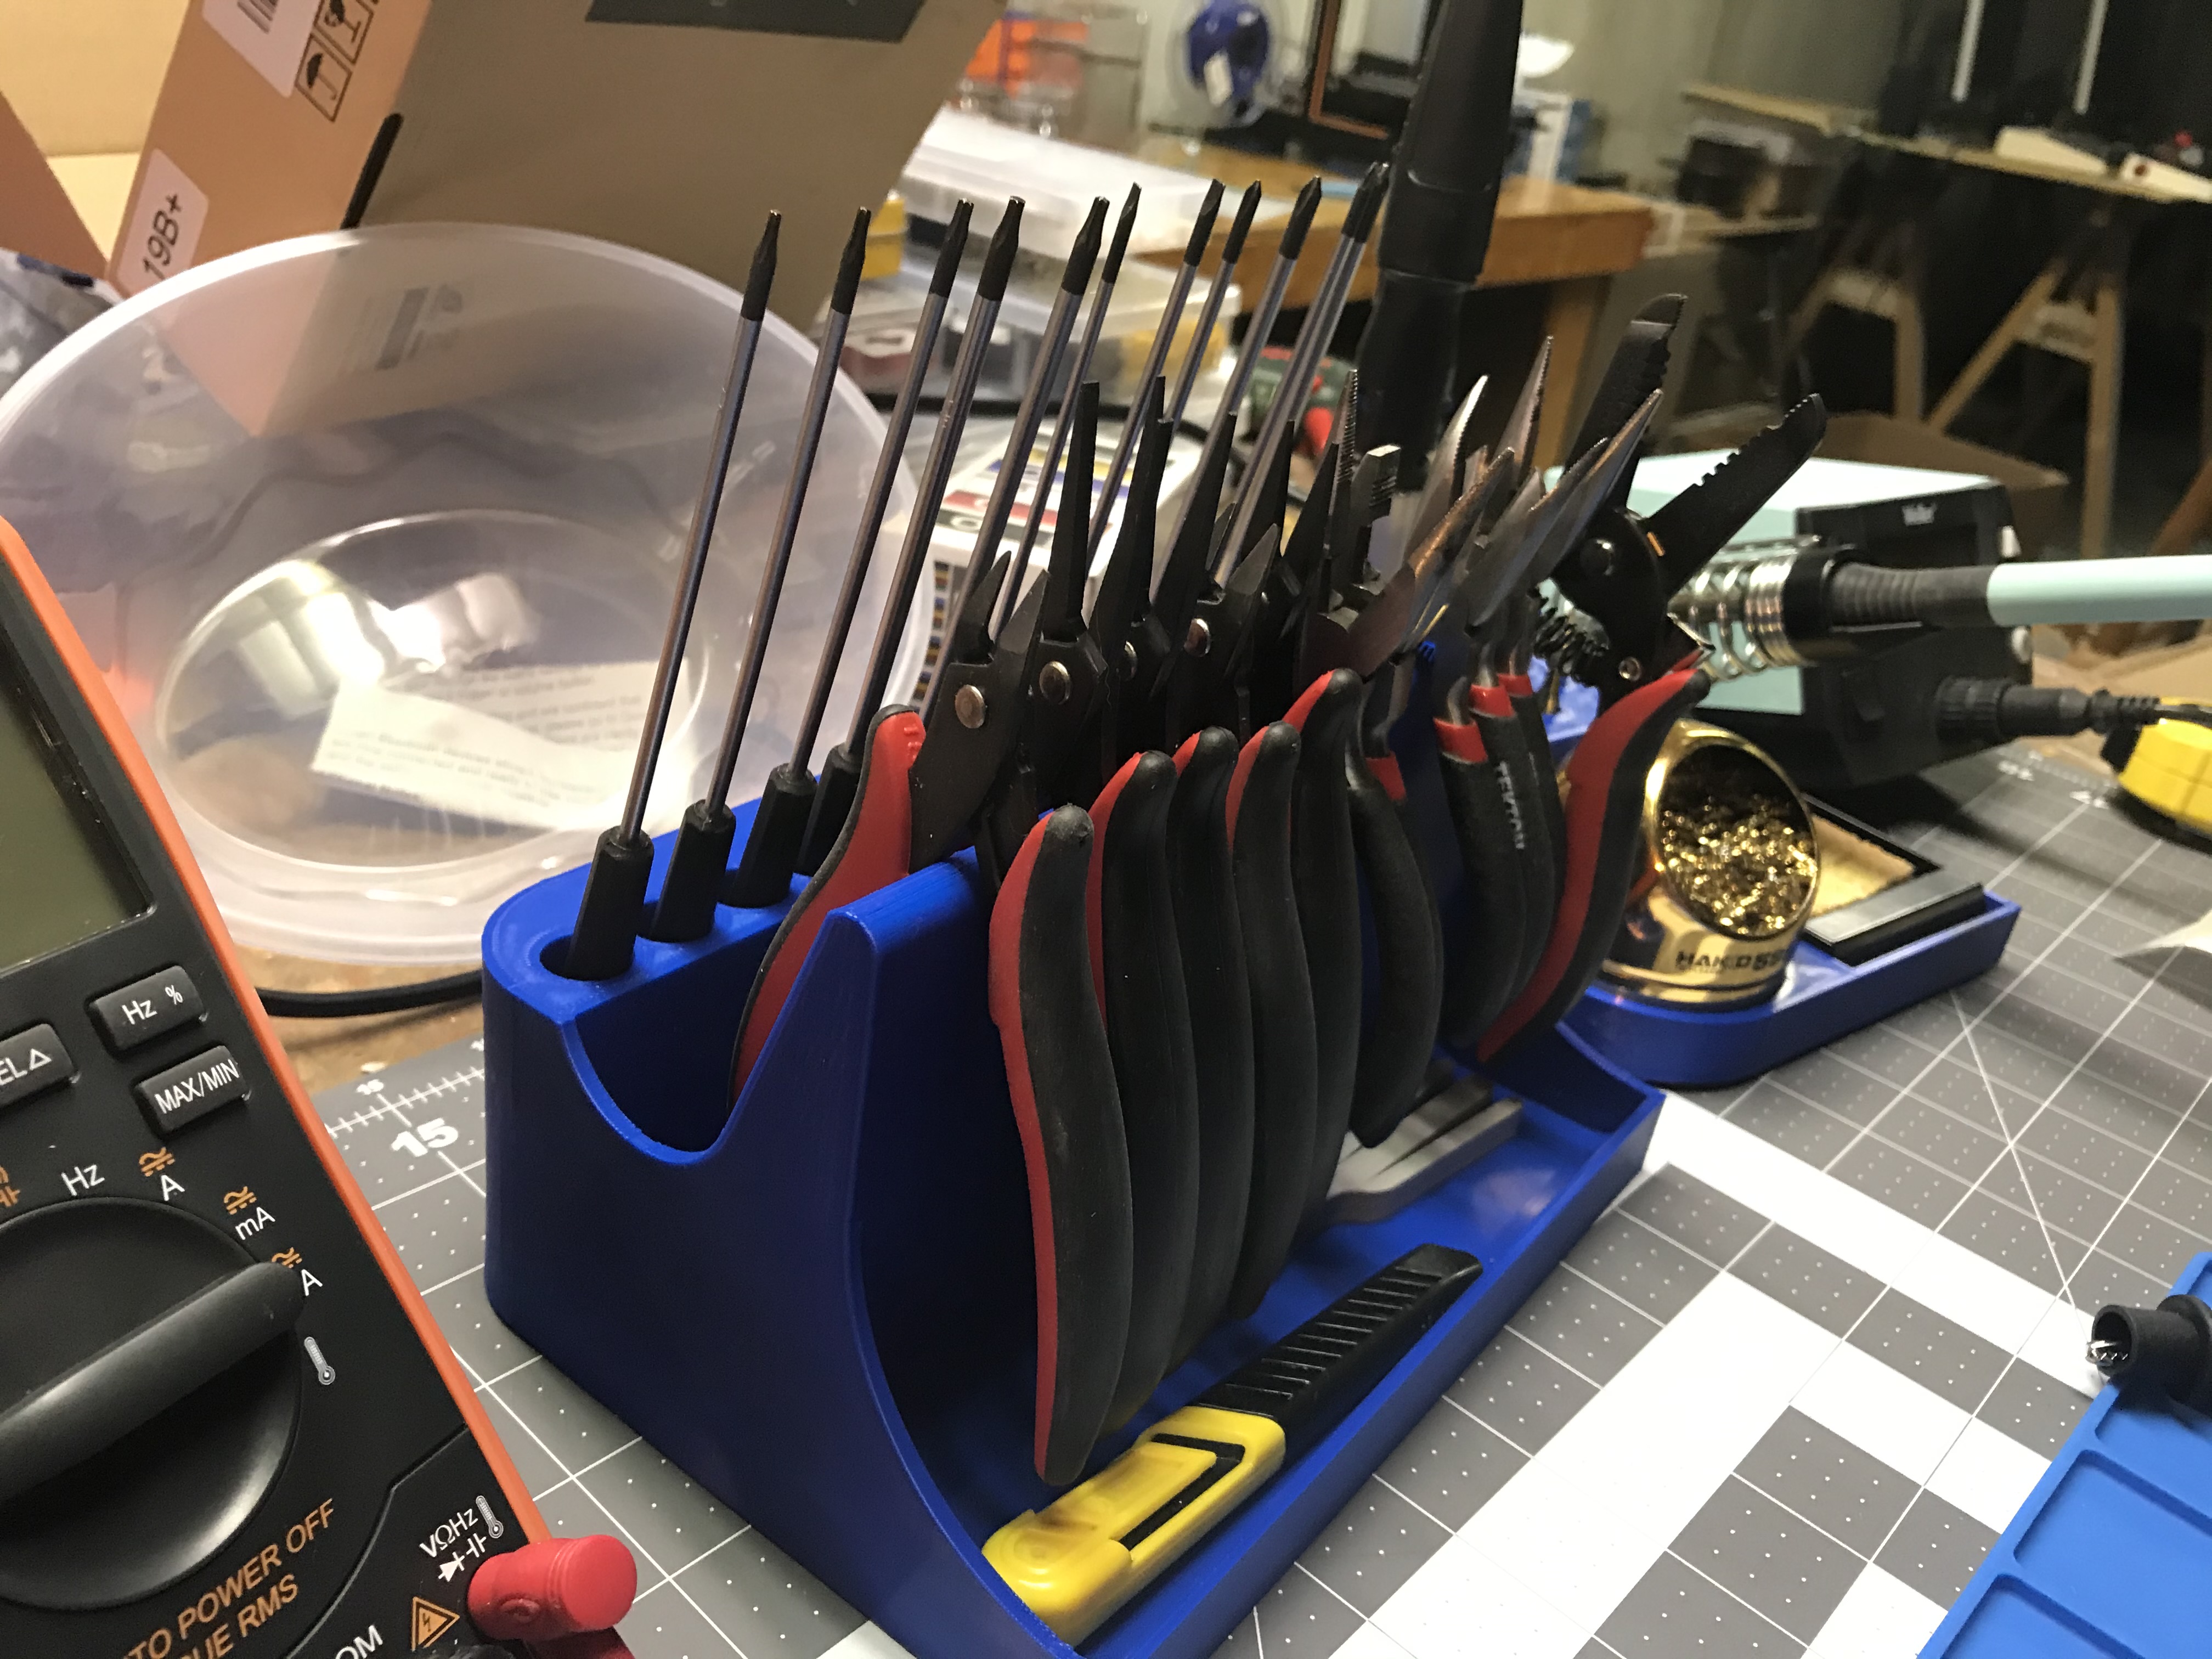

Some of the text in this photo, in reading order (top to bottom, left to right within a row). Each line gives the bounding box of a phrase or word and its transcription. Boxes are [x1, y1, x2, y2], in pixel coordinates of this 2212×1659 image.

[143, 194, 182, 280] 19B+
[122, 985, 183, 1025] Hz %
[154, 1059, 240, 1114] MAX/MIN
[391, 1117, 459, 1157] 15
[61, 1164, 105, 1196] Hz
[161, 1175, 185, 1201] A
[235, 1206, 275, 1240] mA
[178, 1543, 282, 1639] POWER
[286, 1498, 334, 1553] OFF
[237, 1574, 298, 1637] RMS
